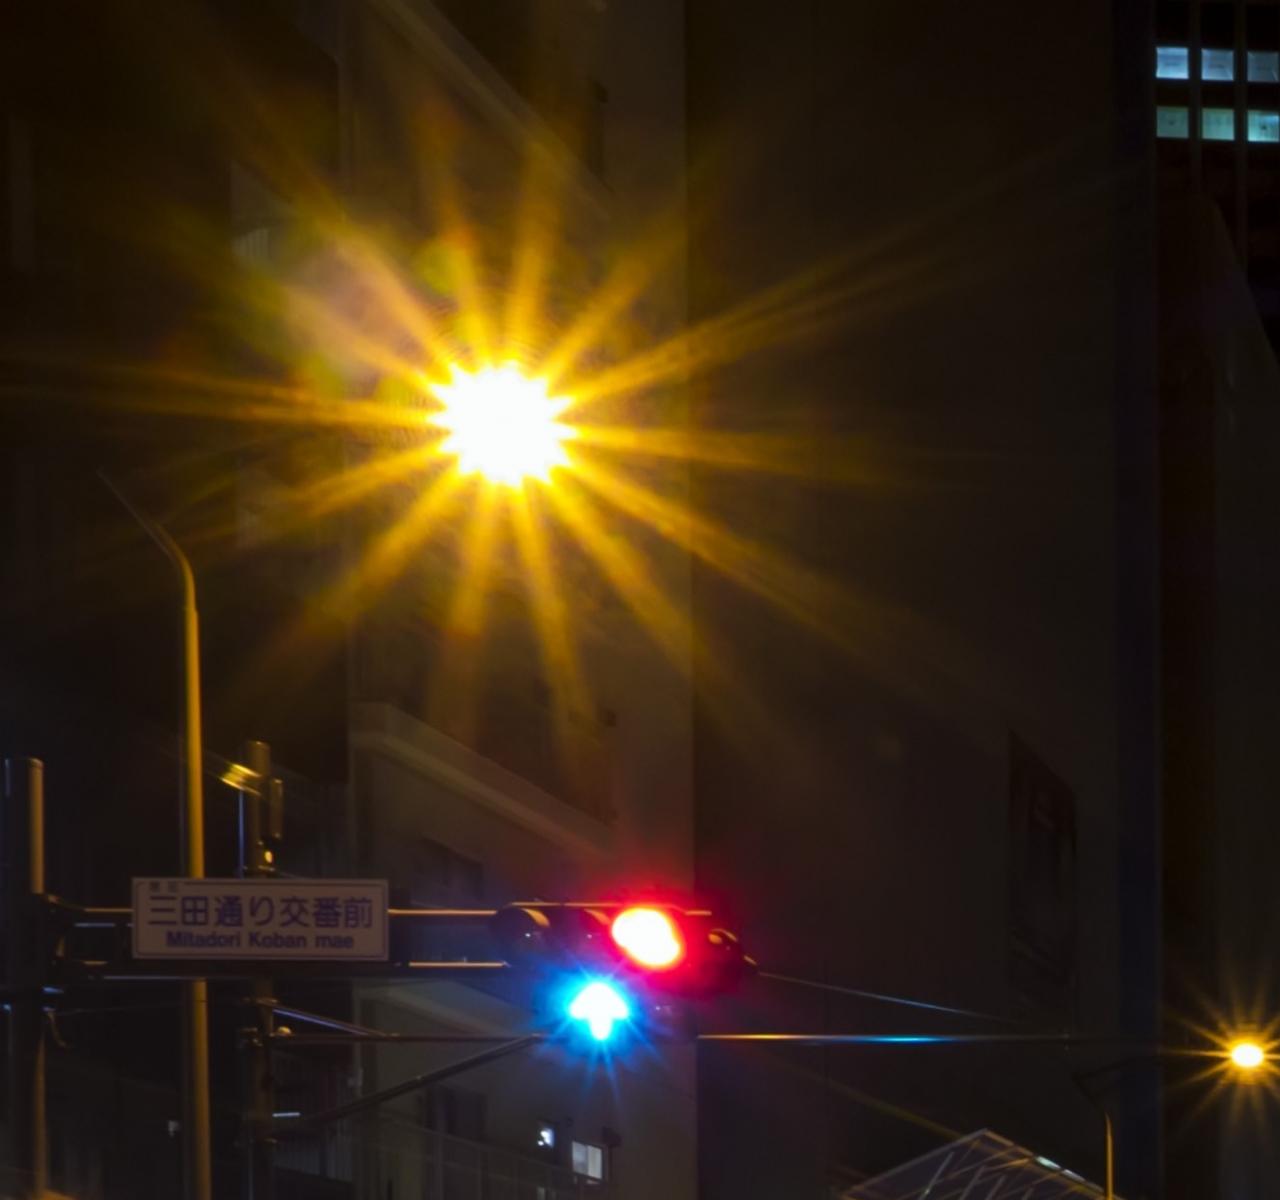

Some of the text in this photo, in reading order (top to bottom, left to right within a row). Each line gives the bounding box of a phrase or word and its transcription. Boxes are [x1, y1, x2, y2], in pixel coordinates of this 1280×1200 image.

[147, 895, 373, 928] 三田通り交番前
[248, 931, 307, 949] Koban
[314, 934, 355, 949] mae
